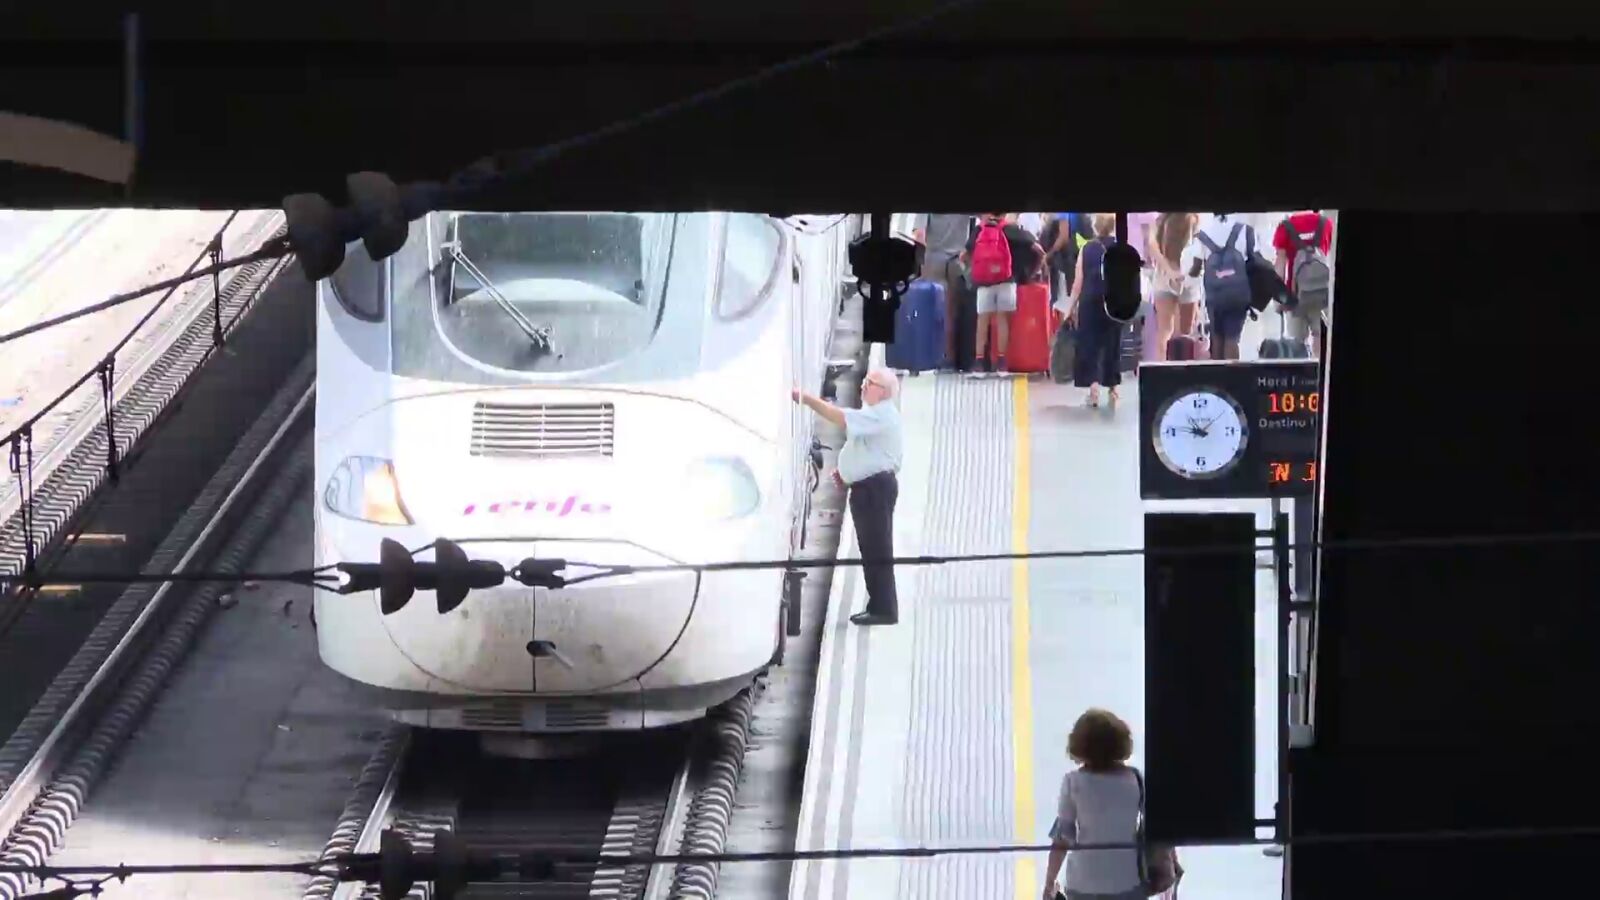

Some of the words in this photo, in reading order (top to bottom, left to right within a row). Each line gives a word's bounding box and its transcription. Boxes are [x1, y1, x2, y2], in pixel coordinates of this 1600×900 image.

[1193, 398, 1208, 409] 12
[1196, 456, 1207, 467] 6
[462, 494, 612, 517] renfe
